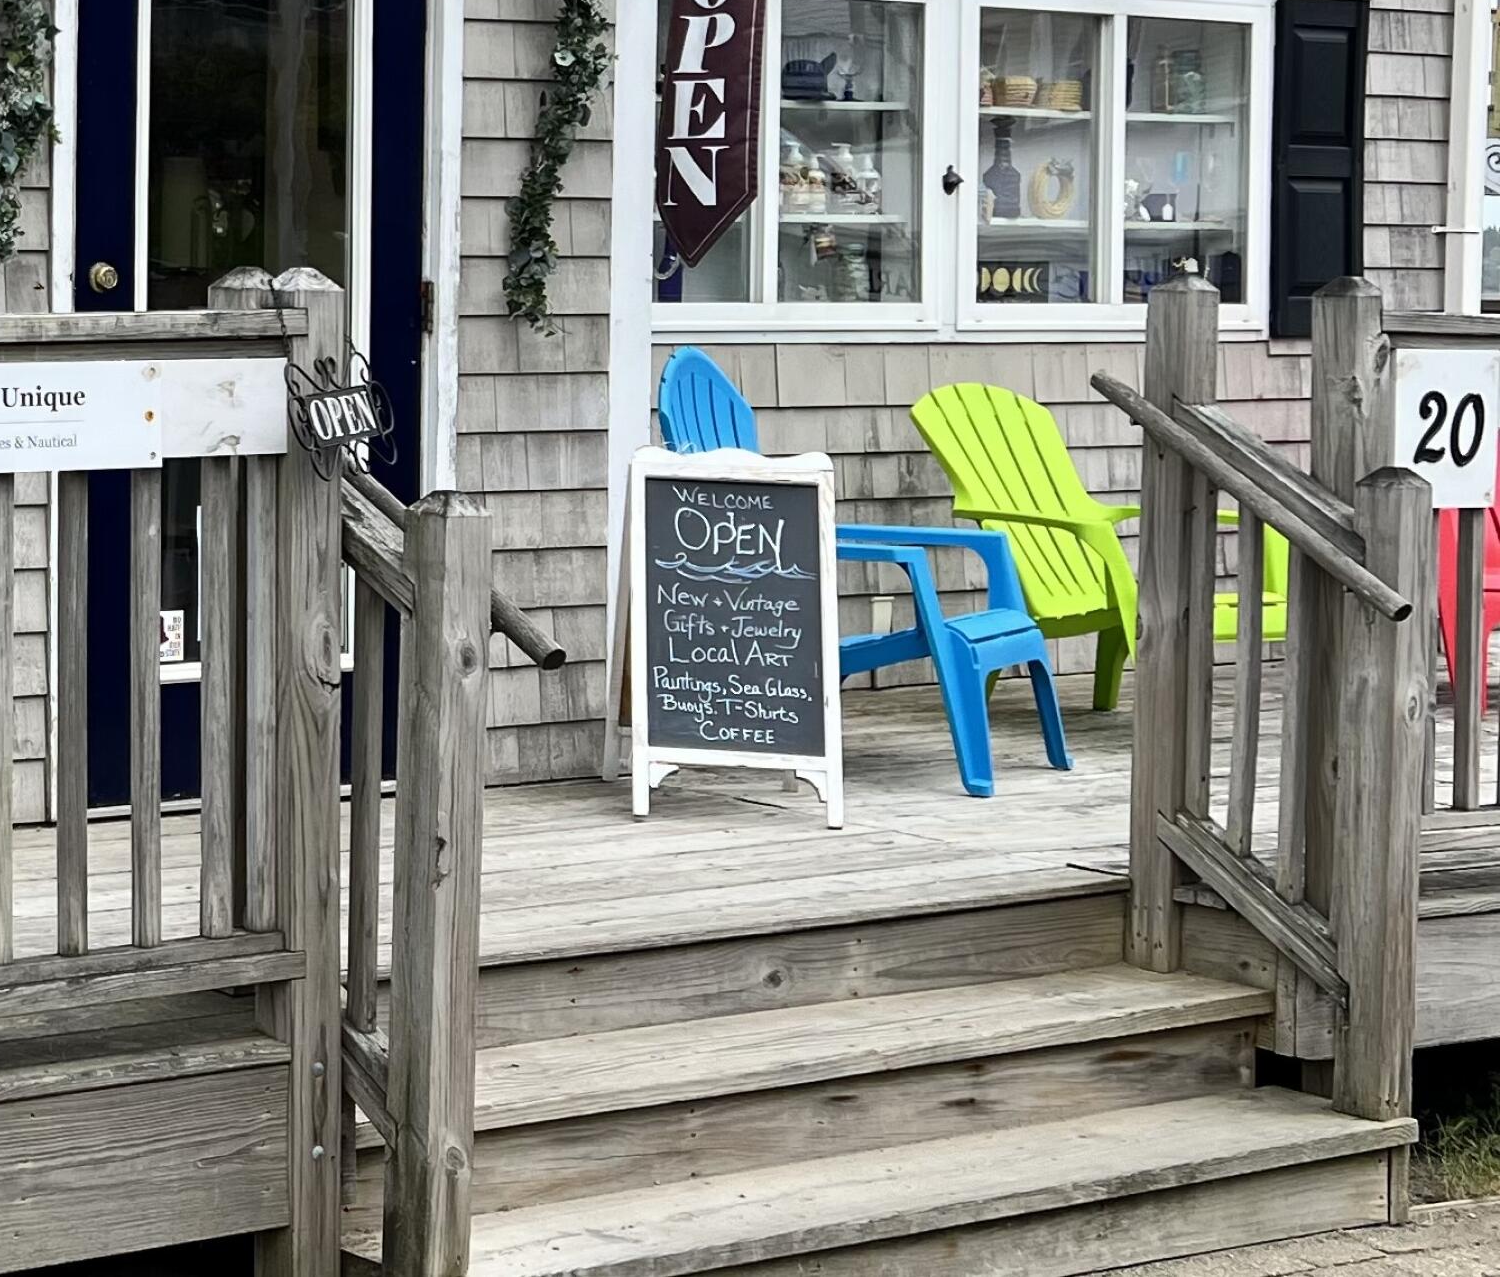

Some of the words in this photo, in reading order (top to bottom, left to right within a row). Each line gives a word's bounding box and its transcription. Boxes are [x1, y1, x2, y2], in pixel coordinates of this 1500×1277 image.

[2, 385, 86, 412] Unique
[310, 391, 377, 440] OPEN
[1413, 390, 1484, 467] 20
[14, 435, 24, 449] &
[27, 433, 77, 449] Nautical
[672, 484, 775, 510] WELCOME
[674, 506, 784, 572] OPEN
[657, 582, 709, 608] New
[723, 587, 800, 617] Vintage
[664, 609, 715, 640] Gifts
[731, 616, 802, 649] Jewelry
[668, 636, 740, 665] Local
[728, 674, 764, 695] Sea
[716, 698, 799, 724] T-Shirts
[700, 720, 776, 744] COFFEE
